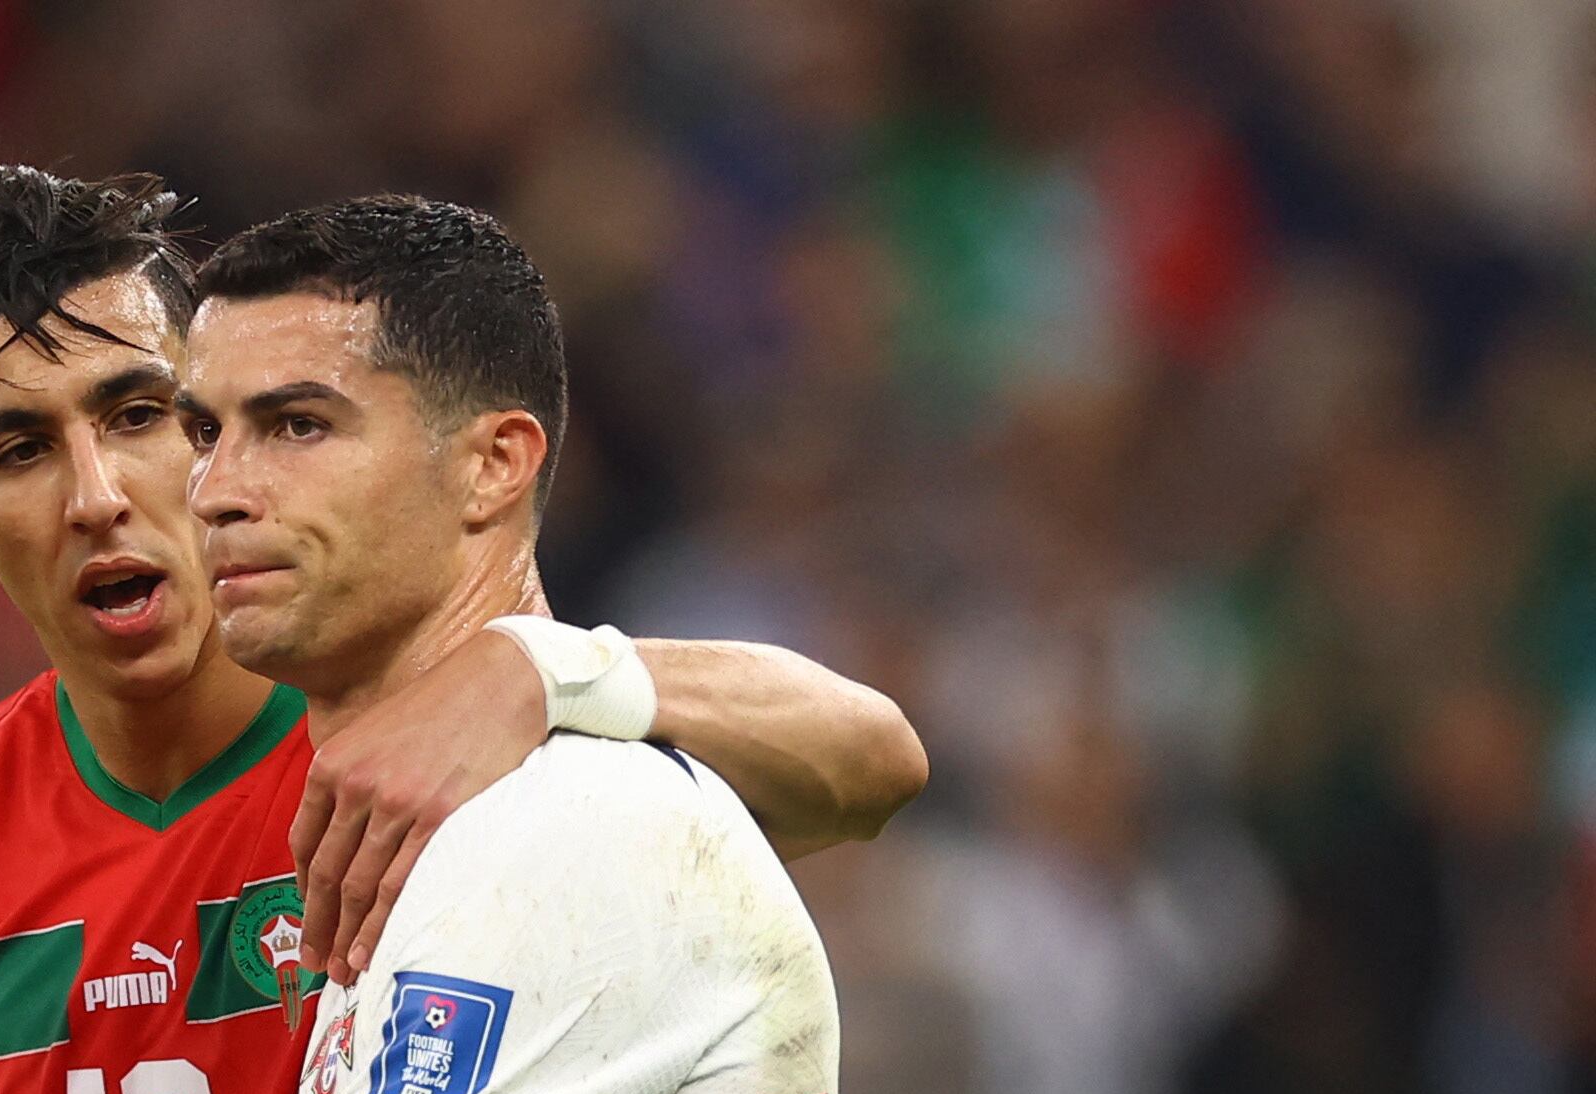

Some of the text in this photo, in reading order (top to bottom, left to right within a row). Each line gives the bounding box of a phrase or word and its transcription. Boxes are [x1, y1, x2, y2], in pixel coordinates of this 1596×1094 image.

[83, 971, 168, 1012] PUMA
[408, 1033, 454, 1055] FOOTBALL
[407, 1048, 452, 1073] UNITES
